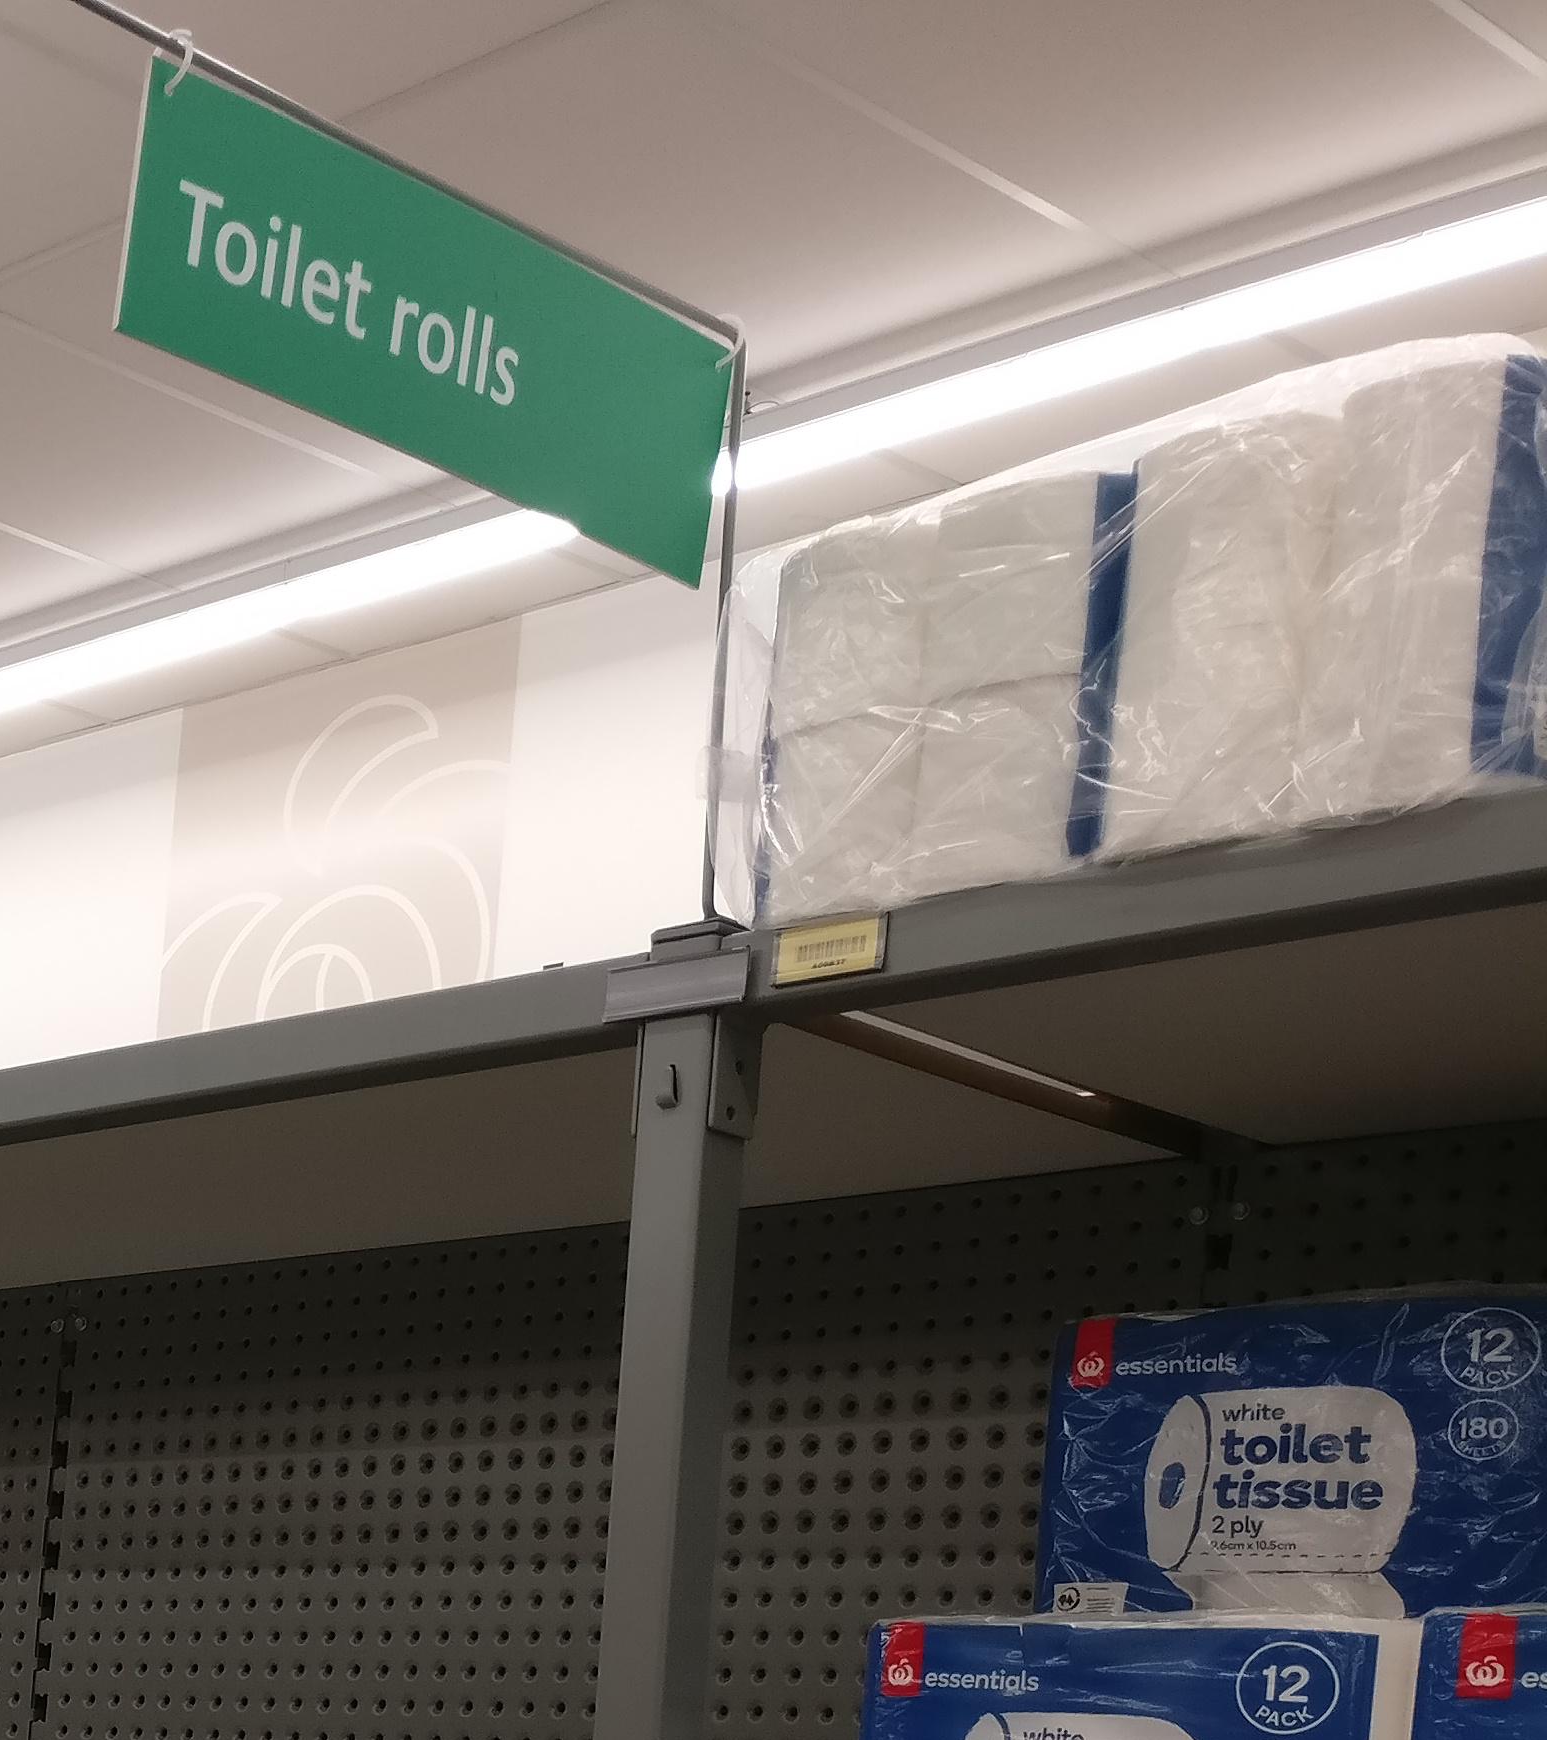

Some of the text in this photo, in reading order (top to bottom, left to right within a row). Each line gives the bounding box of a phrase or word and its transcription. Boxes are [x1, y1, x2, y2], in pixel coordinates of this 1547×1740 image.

[179, 178, 520, 406] Toilet rolls
[1466, 1327, 1515, 1363] 12
[1115, 1351, 1238, 1377] essentials
[1459, 1363, 1520, 1387] PACK
[1222, 1402, 1286, 1422] white
[1458, 1416, 1509, 1440] 180
[1220, 1422, 1372, 1466] toilet
[1213, 1469, 1384, 1511] tissue
[1212, 1516, 1264, 1539] 2 ply
[1255, 1539, 1297, 1552] 10.5cm
[924, 1668, 1039, 1692] essentials
[1262, 1664, 1311, 1703] 12
[1255, 1703, 1314, 1730] PACK
